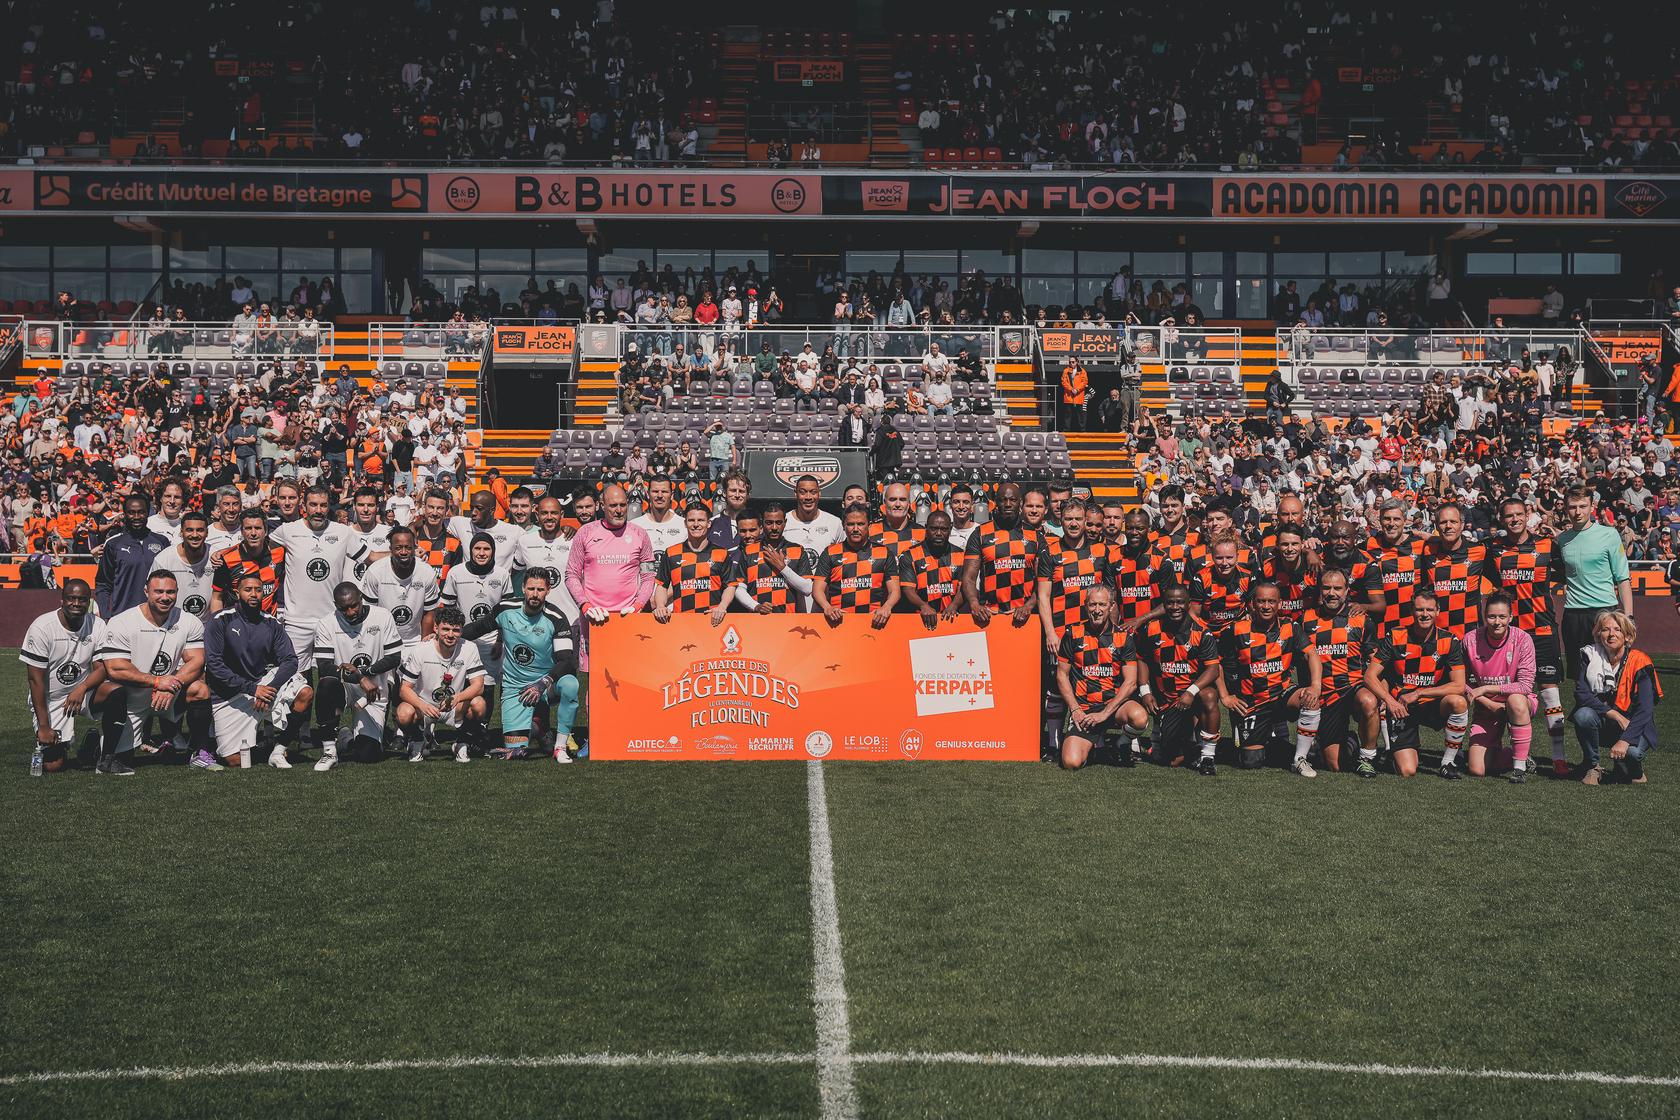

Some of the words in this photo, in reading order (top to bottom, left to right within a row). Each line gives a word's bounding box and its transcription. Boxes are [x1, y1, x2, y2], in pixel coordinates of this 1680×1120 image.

[87, 182, 153, 201] Crédit
[159, 183, 235, 202] Mutuel
[241, 184, 268, 202] de
[273, 184, 372, 207] Bretagne
[612, 183, 736, 206] HOTELS
[867, 187, 892, 195] JEAN
[1631, 183, 1651, 195] Cité
[928, 184, 1028, 213] JEAN
[1043, 182, 1174, 210] FLOC'H
[1221, 183, 1399, 214] ACADOMIA
[1419, 183, 1598, 215] ACADOMIA
[1624, 193, 1657, 202] marine
[535, 331, 566, 341] JEAN
[1079, 334, 1112, 343] JEAN
[692, 663, 706, 674] LE
[708, 660, 747, 672] MATCH
[750, 661, 769, 674] DES
[663, 671, 800, 711] LÉGENDES
[914, 680, 993, 695] KERPAPE
[692, 711, 707, 729] FC
[710, 708, 770, 728] LORIENT
[627, 739, 665, 748] ADITEC
[845, 736, 856, 745] LE
[860, 736, 880, 745] LOB
